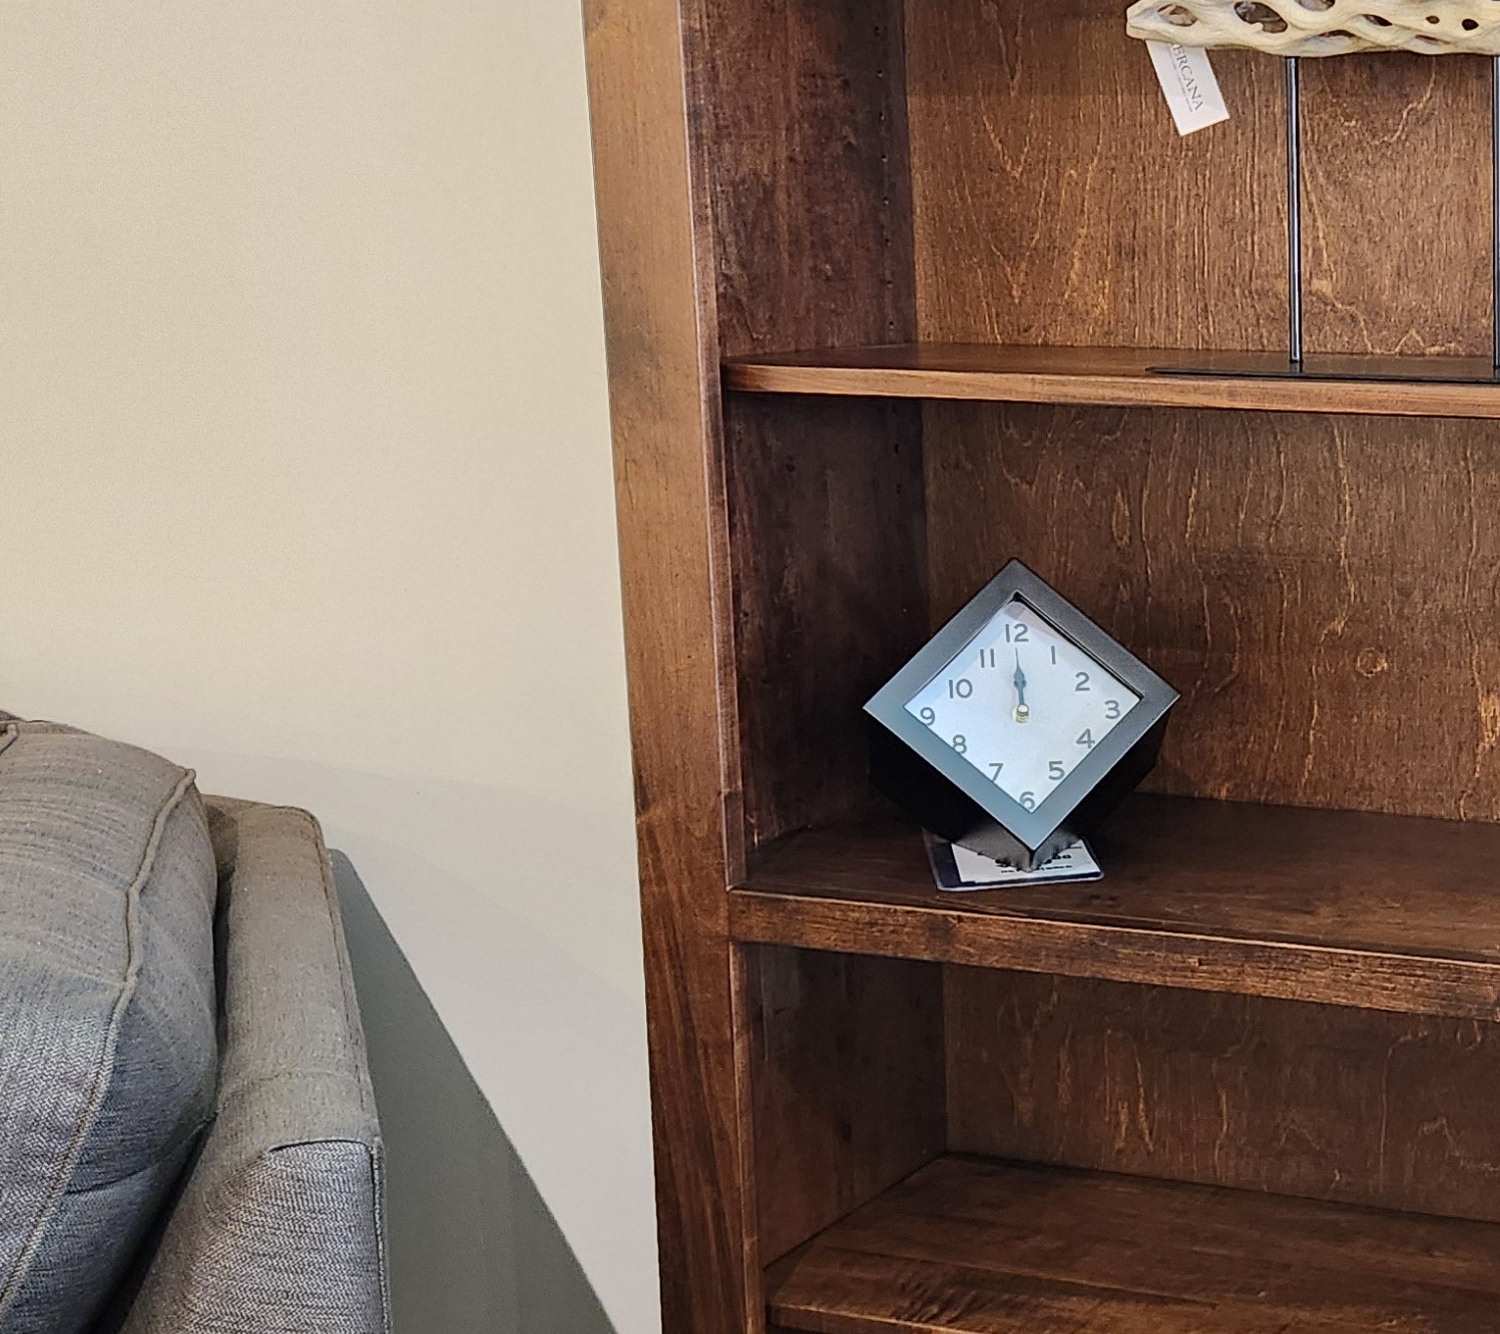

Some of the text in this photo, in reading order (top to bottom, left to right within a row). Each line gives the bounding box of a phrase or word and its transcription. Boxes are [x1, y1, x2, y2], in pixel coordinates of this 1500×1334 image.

[1171, 43, 1203, 111] ERCANA
[1005, 623, 1029, 643] 12
[980, 649, 995, 668] 11
[1051, 645, 1057, 665] 1
[949, 679, 973, 698] 10
[1075, 672, 1090, 691] 2
[920, 706, 937, 727] 9
[1104, 699, 1121, 719] 3
[952, 734, 968, 754] 8
[1076, 728, 1096, 749] 4
[988, 762, 1004, 782] 7
[1048, 760, 1065, 781] 5
[1018, 791, 1036, 811] 6
